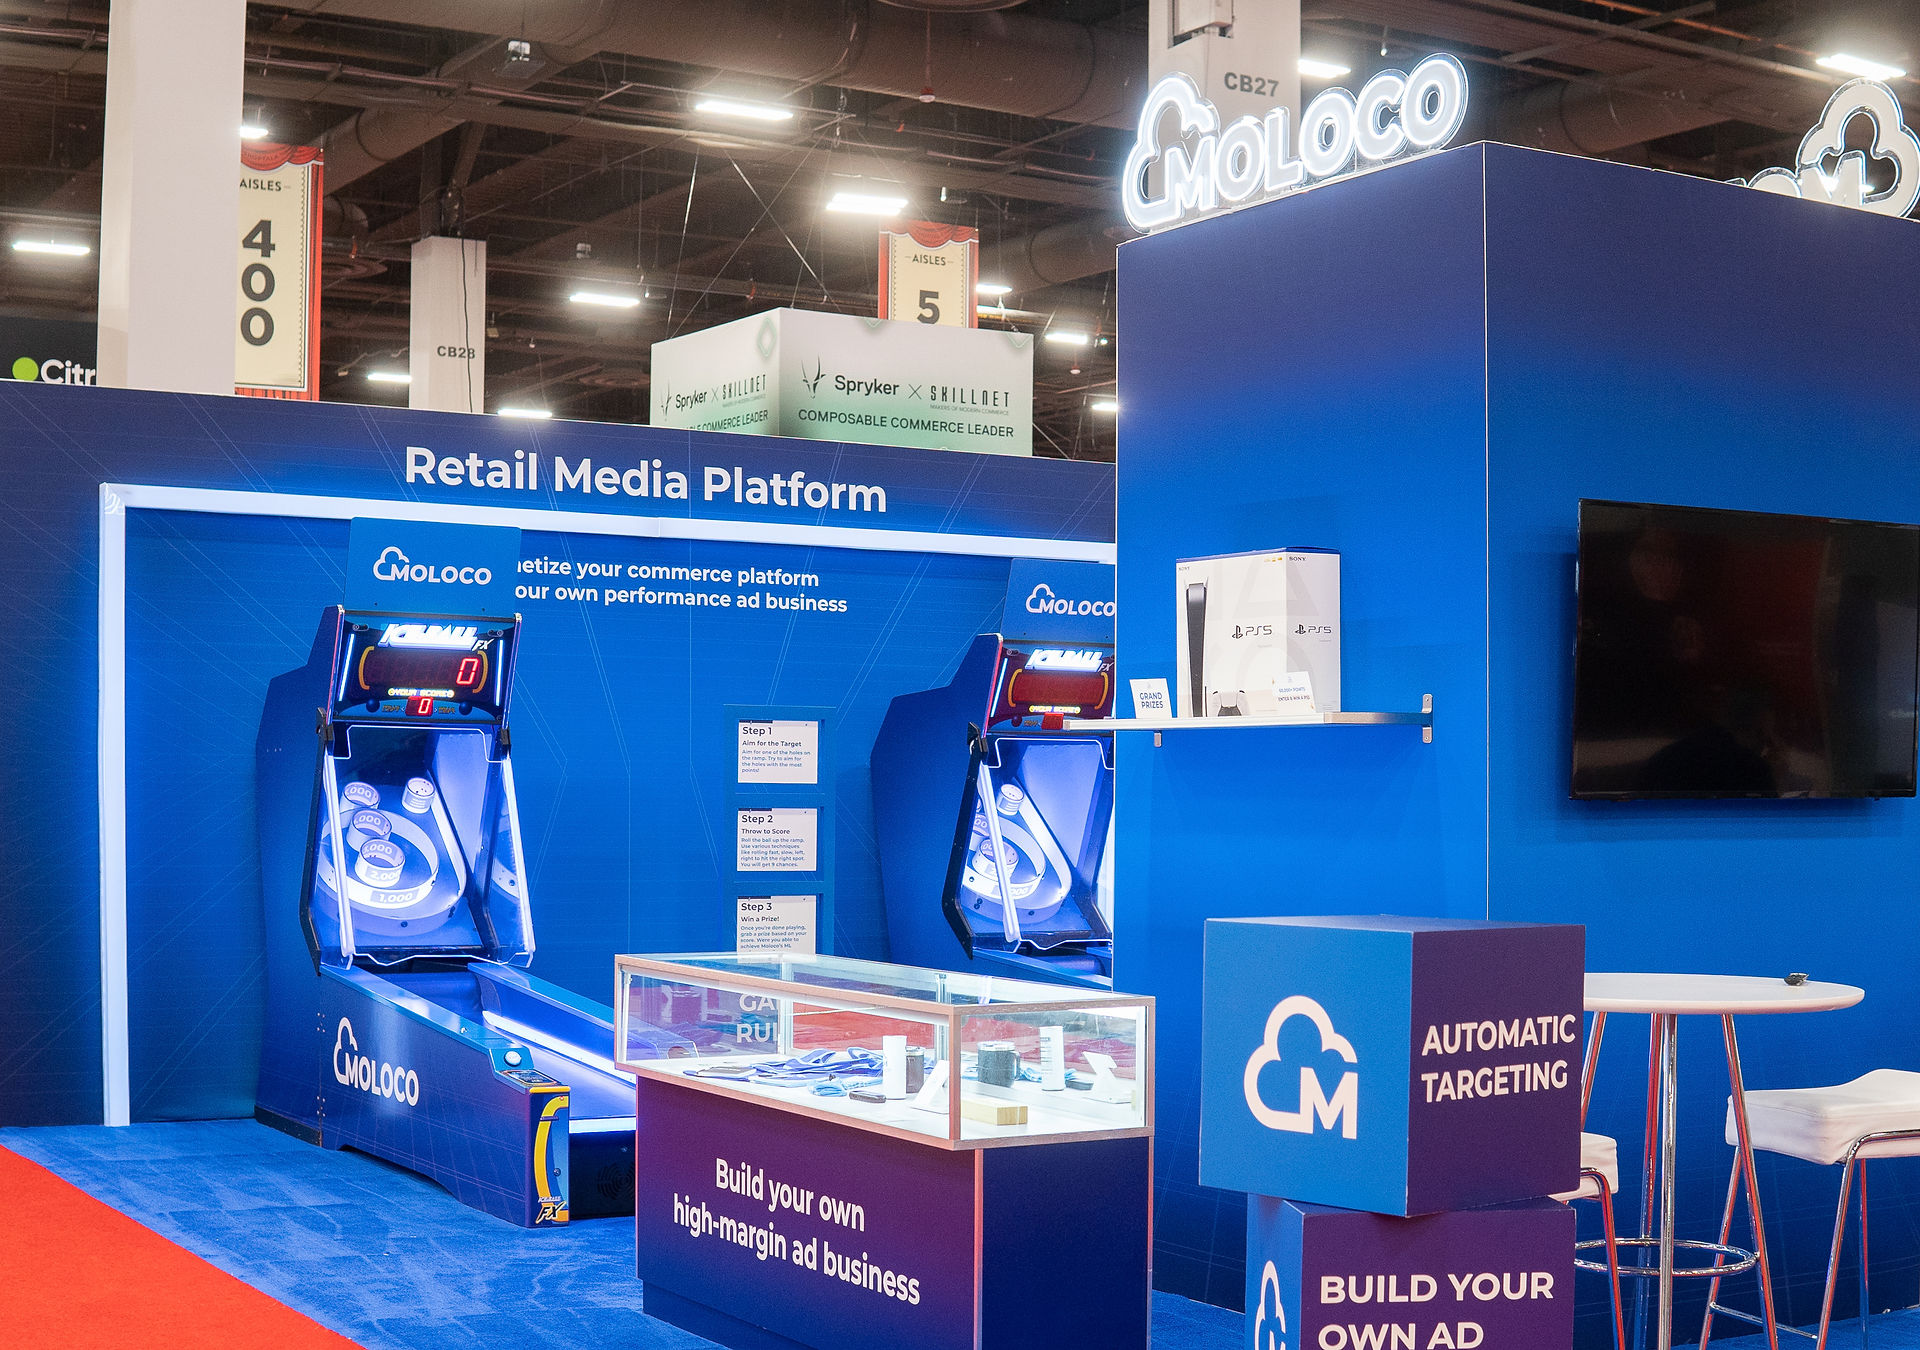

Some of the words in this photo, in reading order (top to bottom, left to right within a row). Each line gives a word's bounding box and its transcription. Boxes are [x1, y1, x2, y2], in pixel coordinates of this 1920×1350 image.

[1224, 72, 1279, 97] CB27
[1165, 53, 1470, 211] MOLOCO
[240, 178, 282, 191] AISLES
[912, 254, 946, 266] AISLES
[917, 290, 940, 324] 5
[437, 345, 476, 360] CB28
[834, 375, 899, 397] Spryker
[676, 390, 707, 411] Spryker
[742, 409, 769, 426] LEADER
[798, 409, 887, 427] COMPOSABLE
[891, 417, 964, 433] COMMERCE
[968, 424, 1014, 438] LEADER
[405, 446, 538, 492] Retail
[554, 456, 689, 501] Media
[704, 466, 887, 513] Platform
[391, 564, 492, 585] MOLOCO
[577, 561, 622, 580] your
[627, 564, 732, 583] commerce
[737, 567, 819, 587] platform
[514, 585, 550, 599] our
[555, 587, 598, 601] own
[604, 586, 731, 608] performance
[736, 592, 760, 609] ad
[766, 593, 848, 612] business
[1039, 598, 1115, 617] MOLOCO
[1245, 625, 1273, 636] PS5
[1308, 626, 1332, 634] PS5
[456, 658, 480, 685] 0
[418, 698, 431, 714] 0
[1140, 692, 1162, 700] GRAND
[1141, 701, 1163, 709] PRIZES
[742, 727, 766, 736] Step
[768, 727, 772, 735] 1
[742, 815, 765, 824] Step
[768, 815, 773, 823] 2
[741, 903, 764, 912] Step
[1421, 1014, 1576, 1056] AUTOMATIC
[345, 1052, 419, 1107] MOLOCO
[1421, 1059, 1568, 1103] TARGETING
[716, 1158, 764, 1201] Build
[768, 1179, 814, 1212] your
[819, 1195, 865, 1232] own
[535, 1201, 567, 1224] FX
[673, 1192, 787, 1261] high-margin
[792, 1237, 818, 1271] ad
[823, 1241, 920, 1305] business
[1320, 1273, 1438, 1304] BUILD
[1447, 1271, 1554, 1301] YOUR
[1318, 1323, 1416, 1350] OWN
[1427, 1322, 1484, 1350] AD
